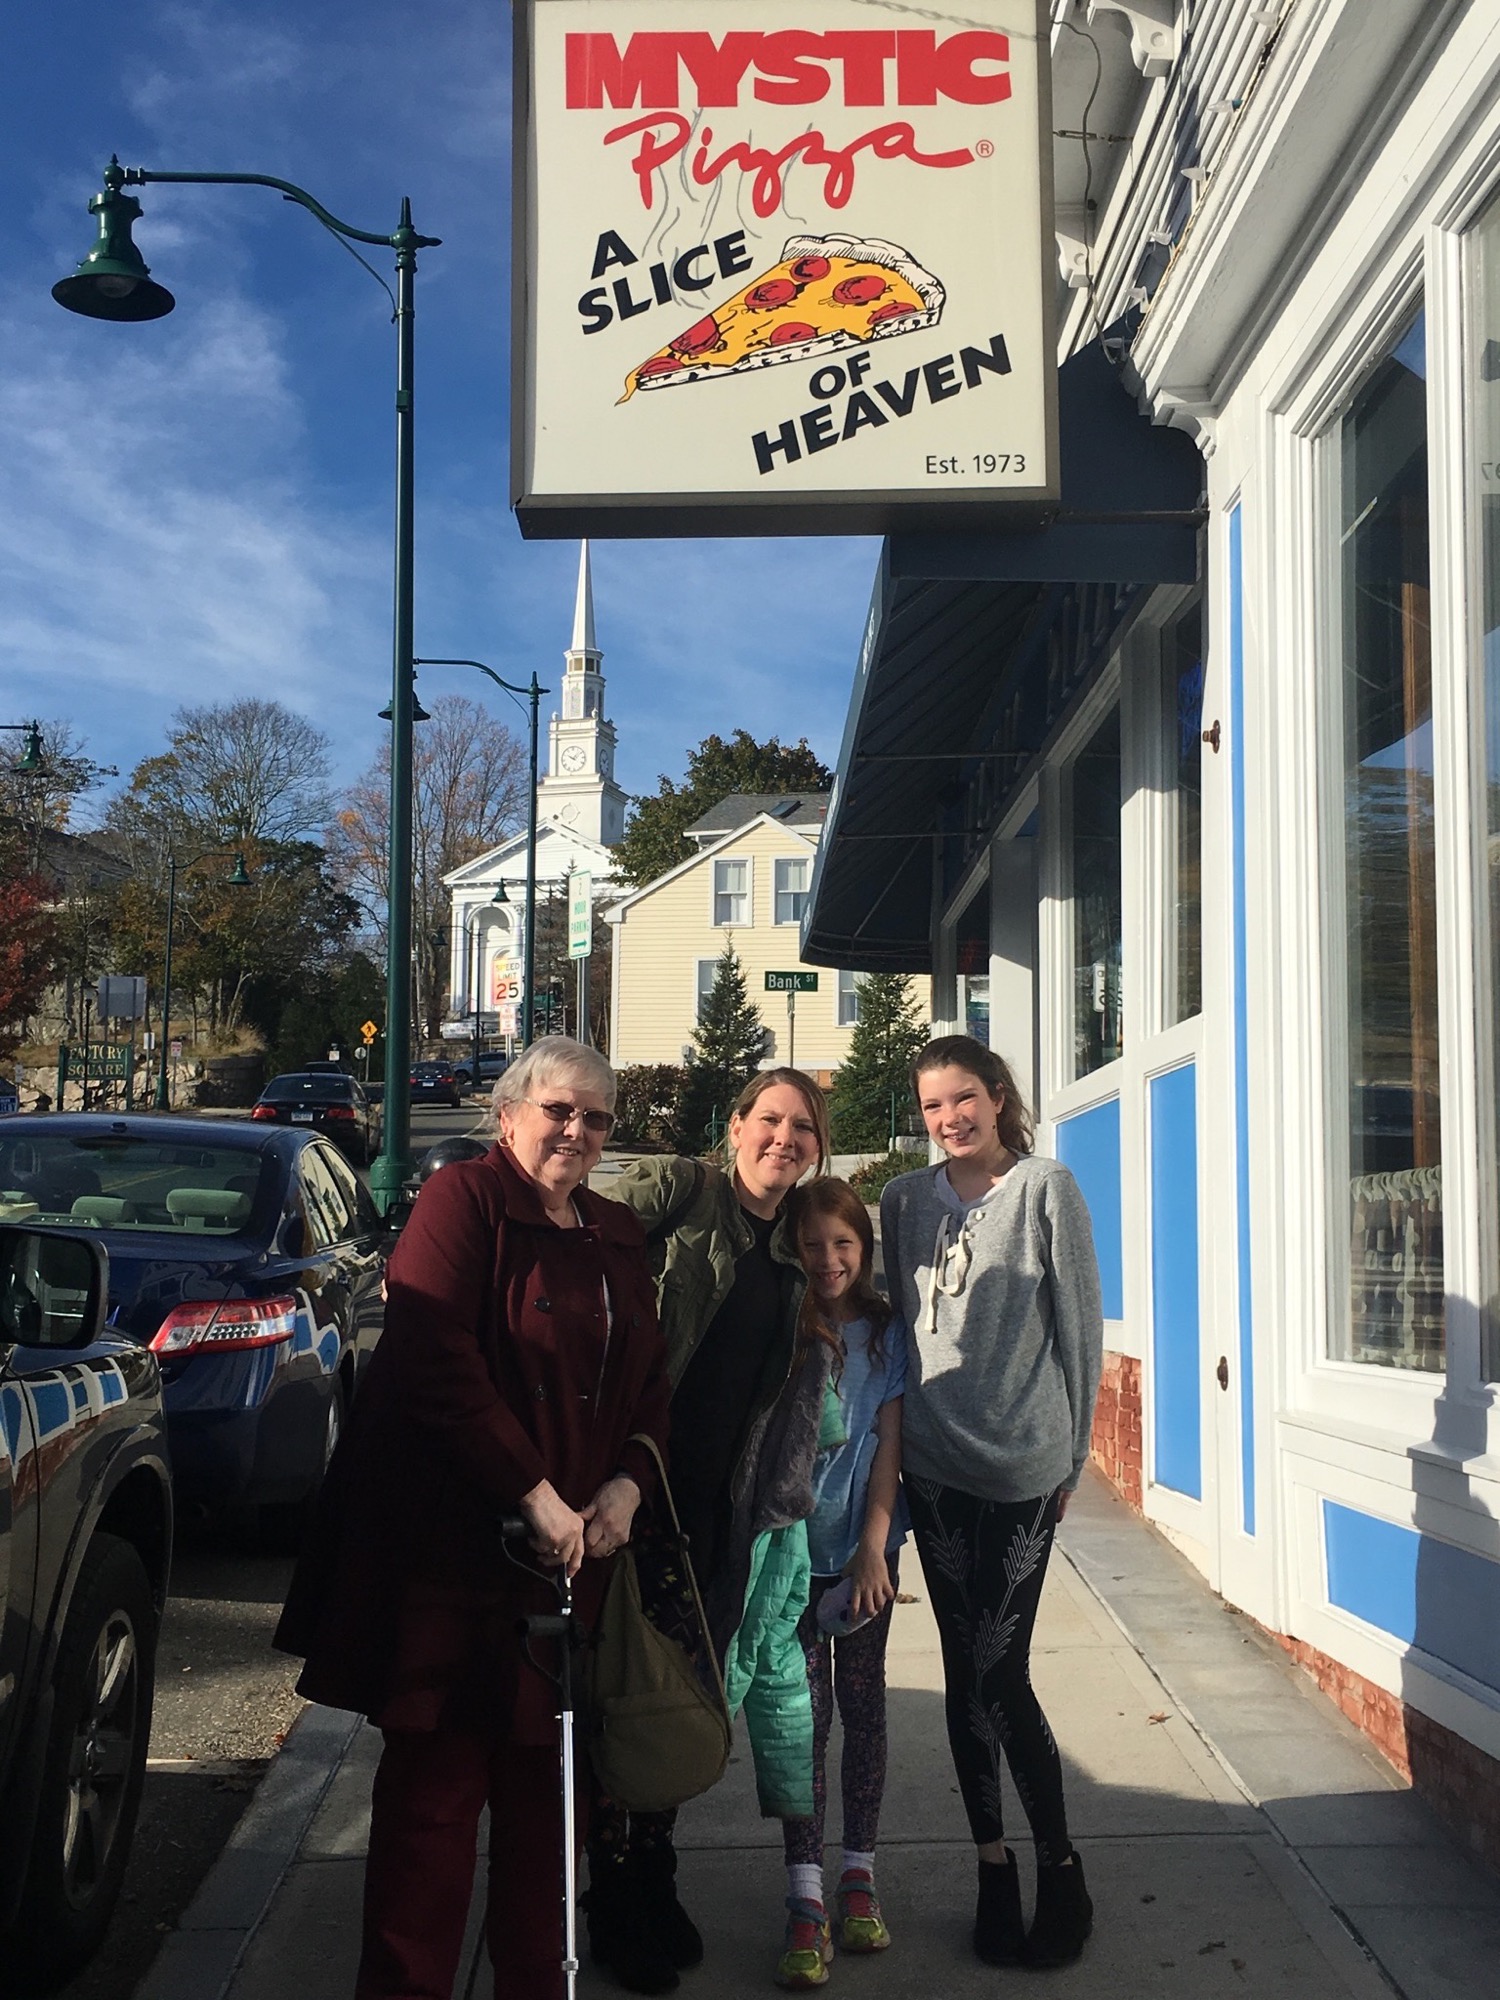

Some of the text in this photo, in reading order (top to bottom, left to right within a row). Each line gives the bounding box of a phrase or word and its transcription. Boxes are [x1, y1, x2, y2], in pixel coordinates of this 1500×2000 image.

[565, 30, 1012, 109] MYSTIC
[603, 111, 975, 218] Pizza
[590, 229, 639, 279] A
[578, 230, 754, 335] SLICE
[809, 350, 871, 400] OF
[751, 333, 1012, 475] HEAVEN
[926, 454, 1026, 474] Est. 1973
[496, 962, 520, 972] SPEED
[498, 972, 517, 981] LIMIT
[768, 974, 815, 989] Bank ST
[496, 981, 519, 1000] 25
[67, 1063, 124, 1078] SQUARE
